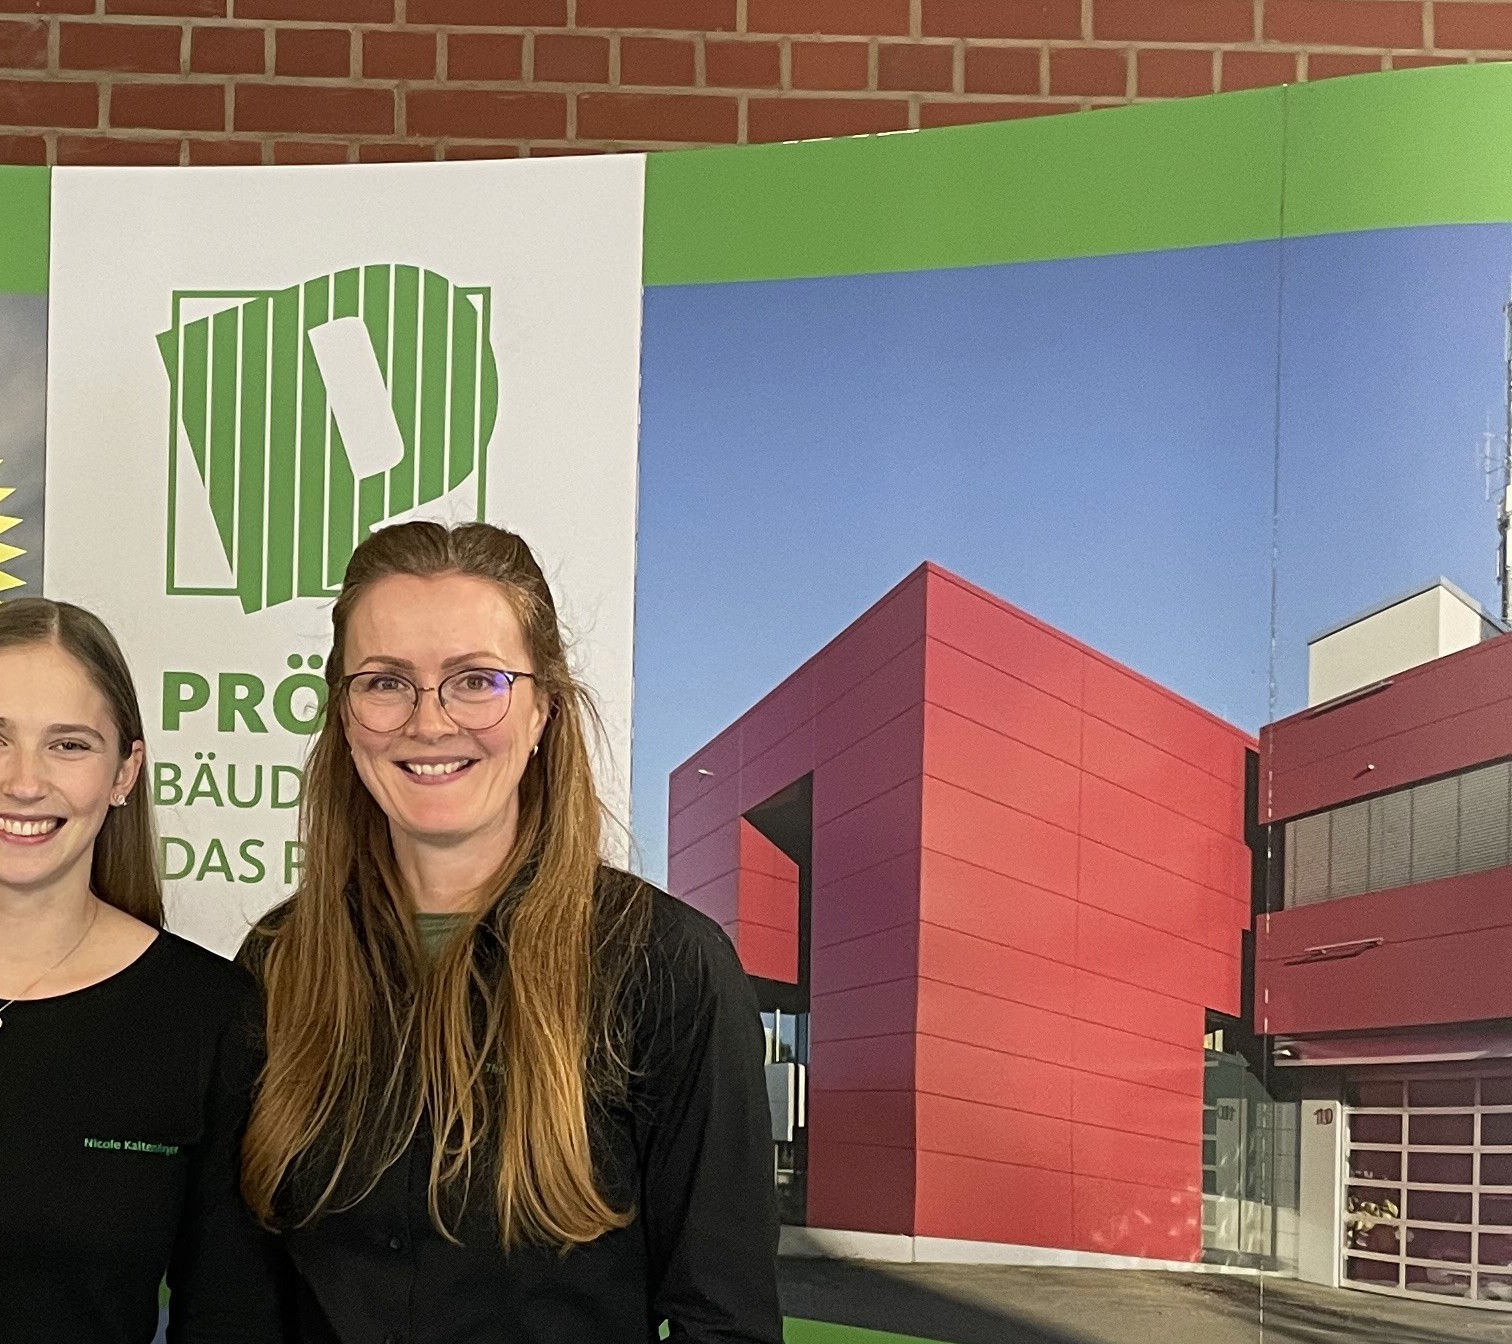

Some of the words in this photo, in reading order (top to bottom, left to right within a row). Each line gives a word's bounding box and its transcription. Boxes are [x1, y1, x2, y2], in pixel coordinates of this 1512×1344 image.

[162, 654, 329, 735] PRÖ
[154, 752, 303, 808] BÄUD
[159, 837, 265, 883] DAS
[84, 1138, 121, 1150] Nicole
